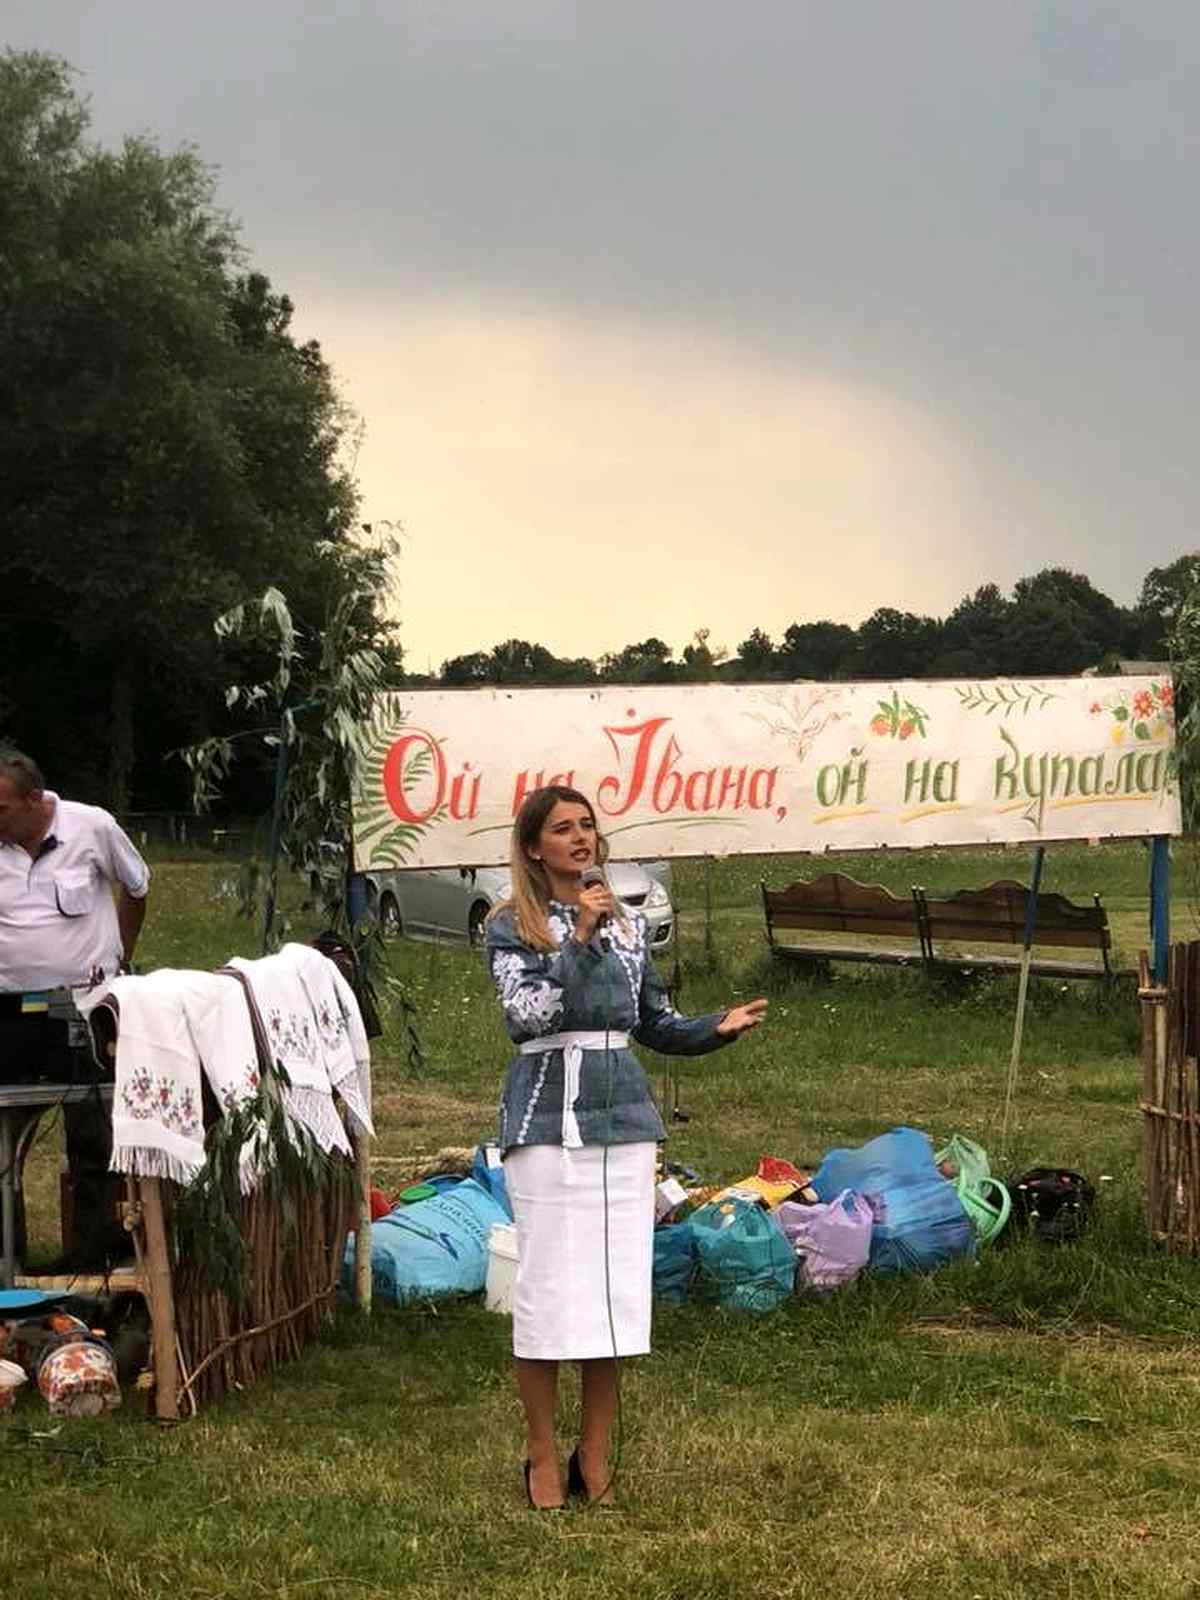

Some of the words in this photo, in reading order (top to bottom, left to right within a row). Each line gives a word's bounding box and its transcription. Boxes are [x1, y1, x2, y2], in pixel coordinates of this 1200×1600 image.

[597, 708, 787, 823] Івана,
[816, 744, 868, 807] ой
[904, 757, 960, 803] на
